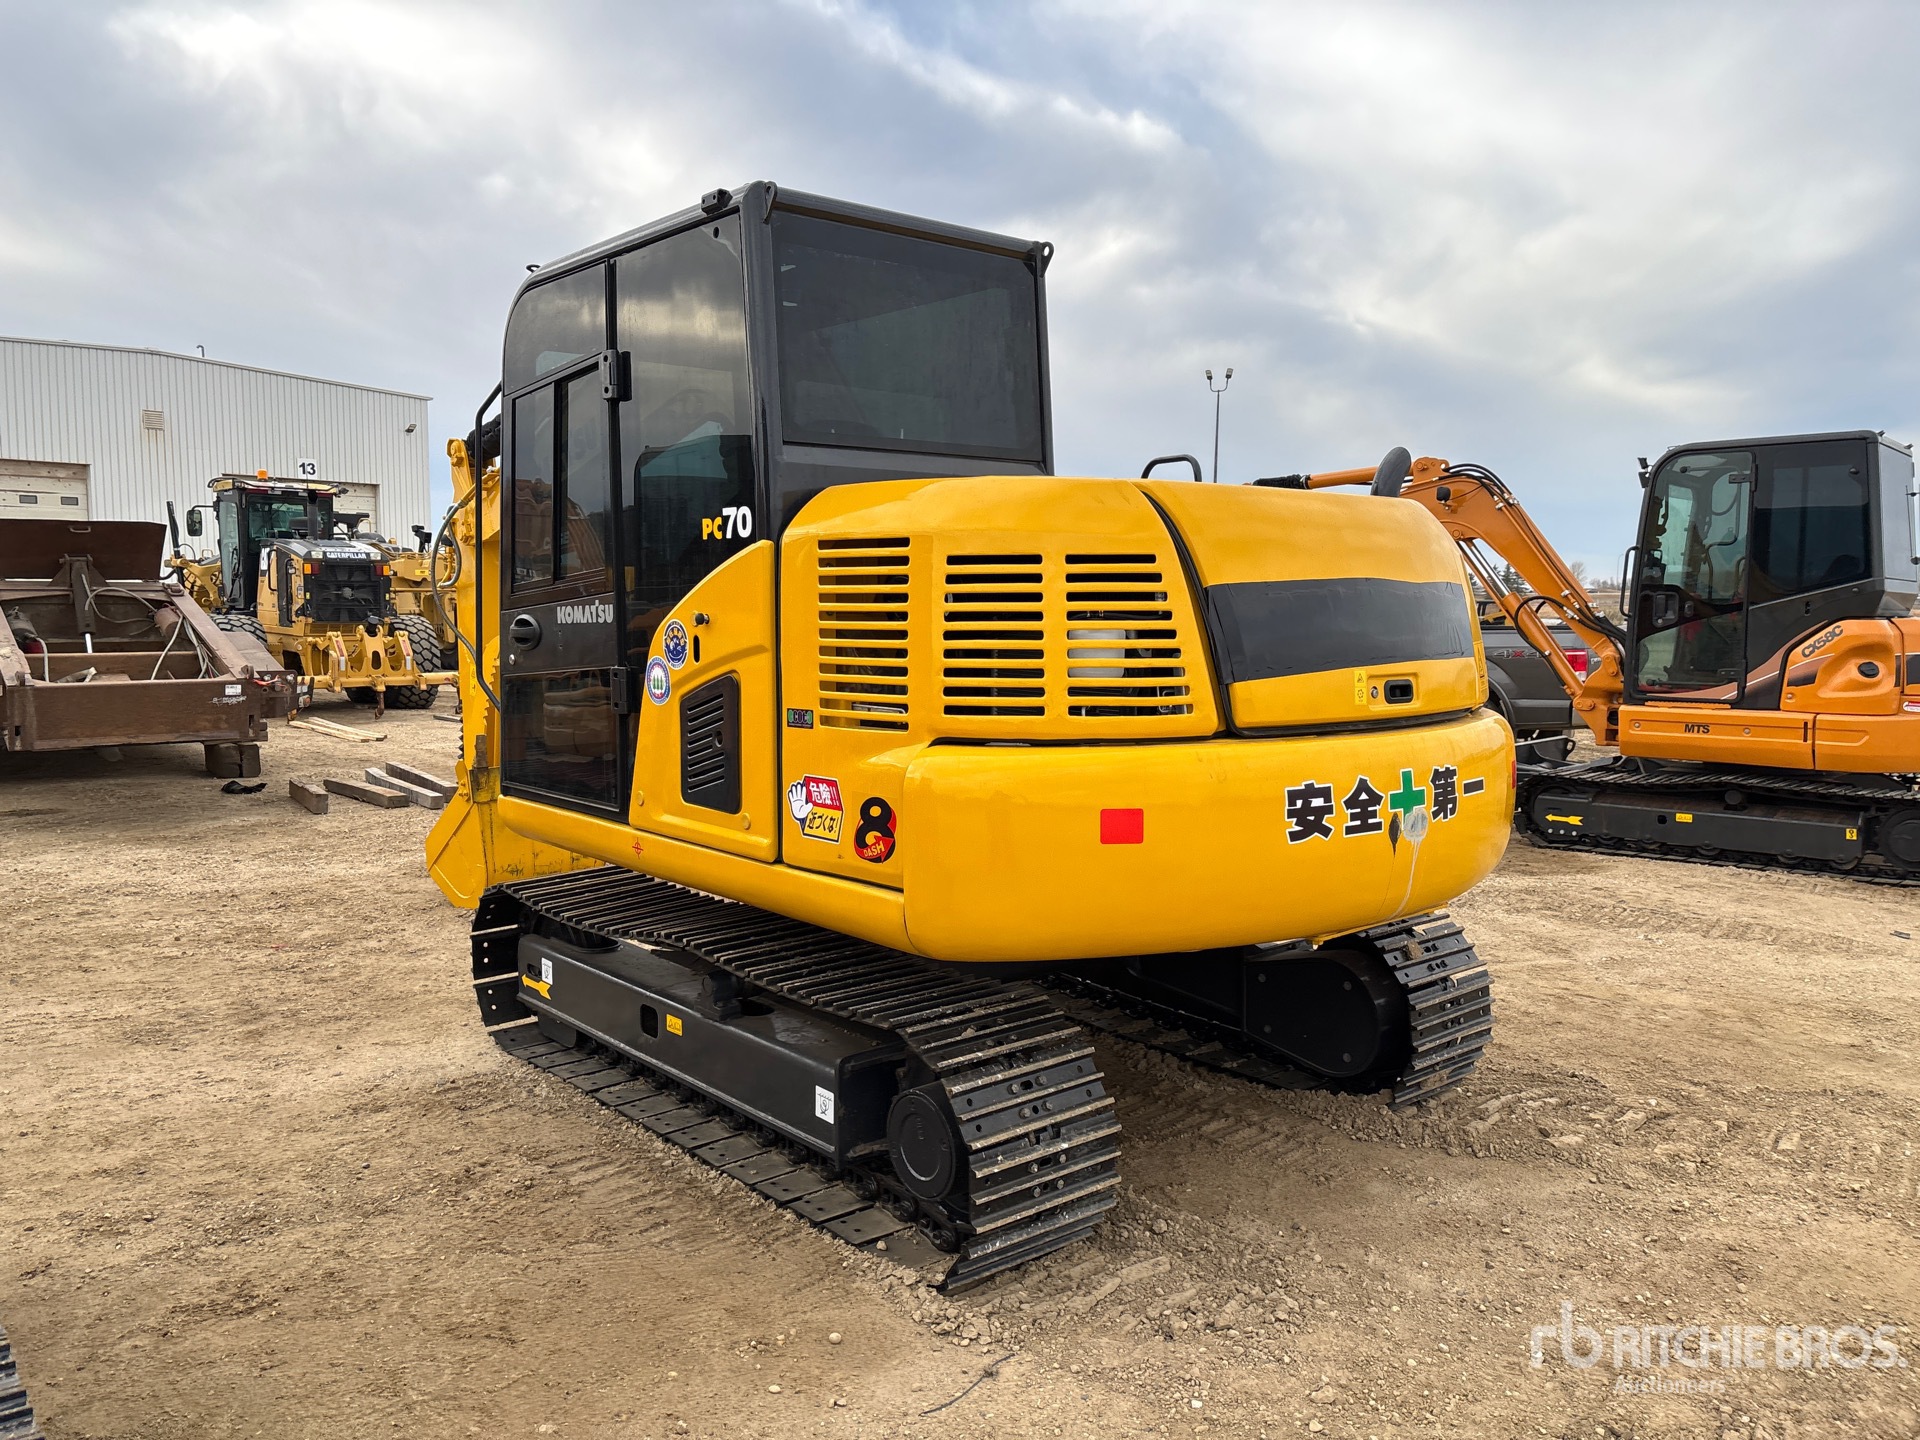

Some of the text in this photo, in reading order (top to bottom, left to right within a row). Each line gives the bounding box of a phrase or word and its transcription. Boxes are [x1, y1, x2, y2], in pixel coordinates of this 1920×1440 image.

[298, 462, 317, 476] 13
[702, 506, 752, 540] PC70
[326, 551, 367, 559] CATERPILLAR
[557, 600, 613, 624] KOMATSU
[1801, 625, 1844, 658] CX58C
[1684, 723, 1711, 734] MTS
[855, 797, 896, 864] 8
[863, 840, 885, 857] DASH
